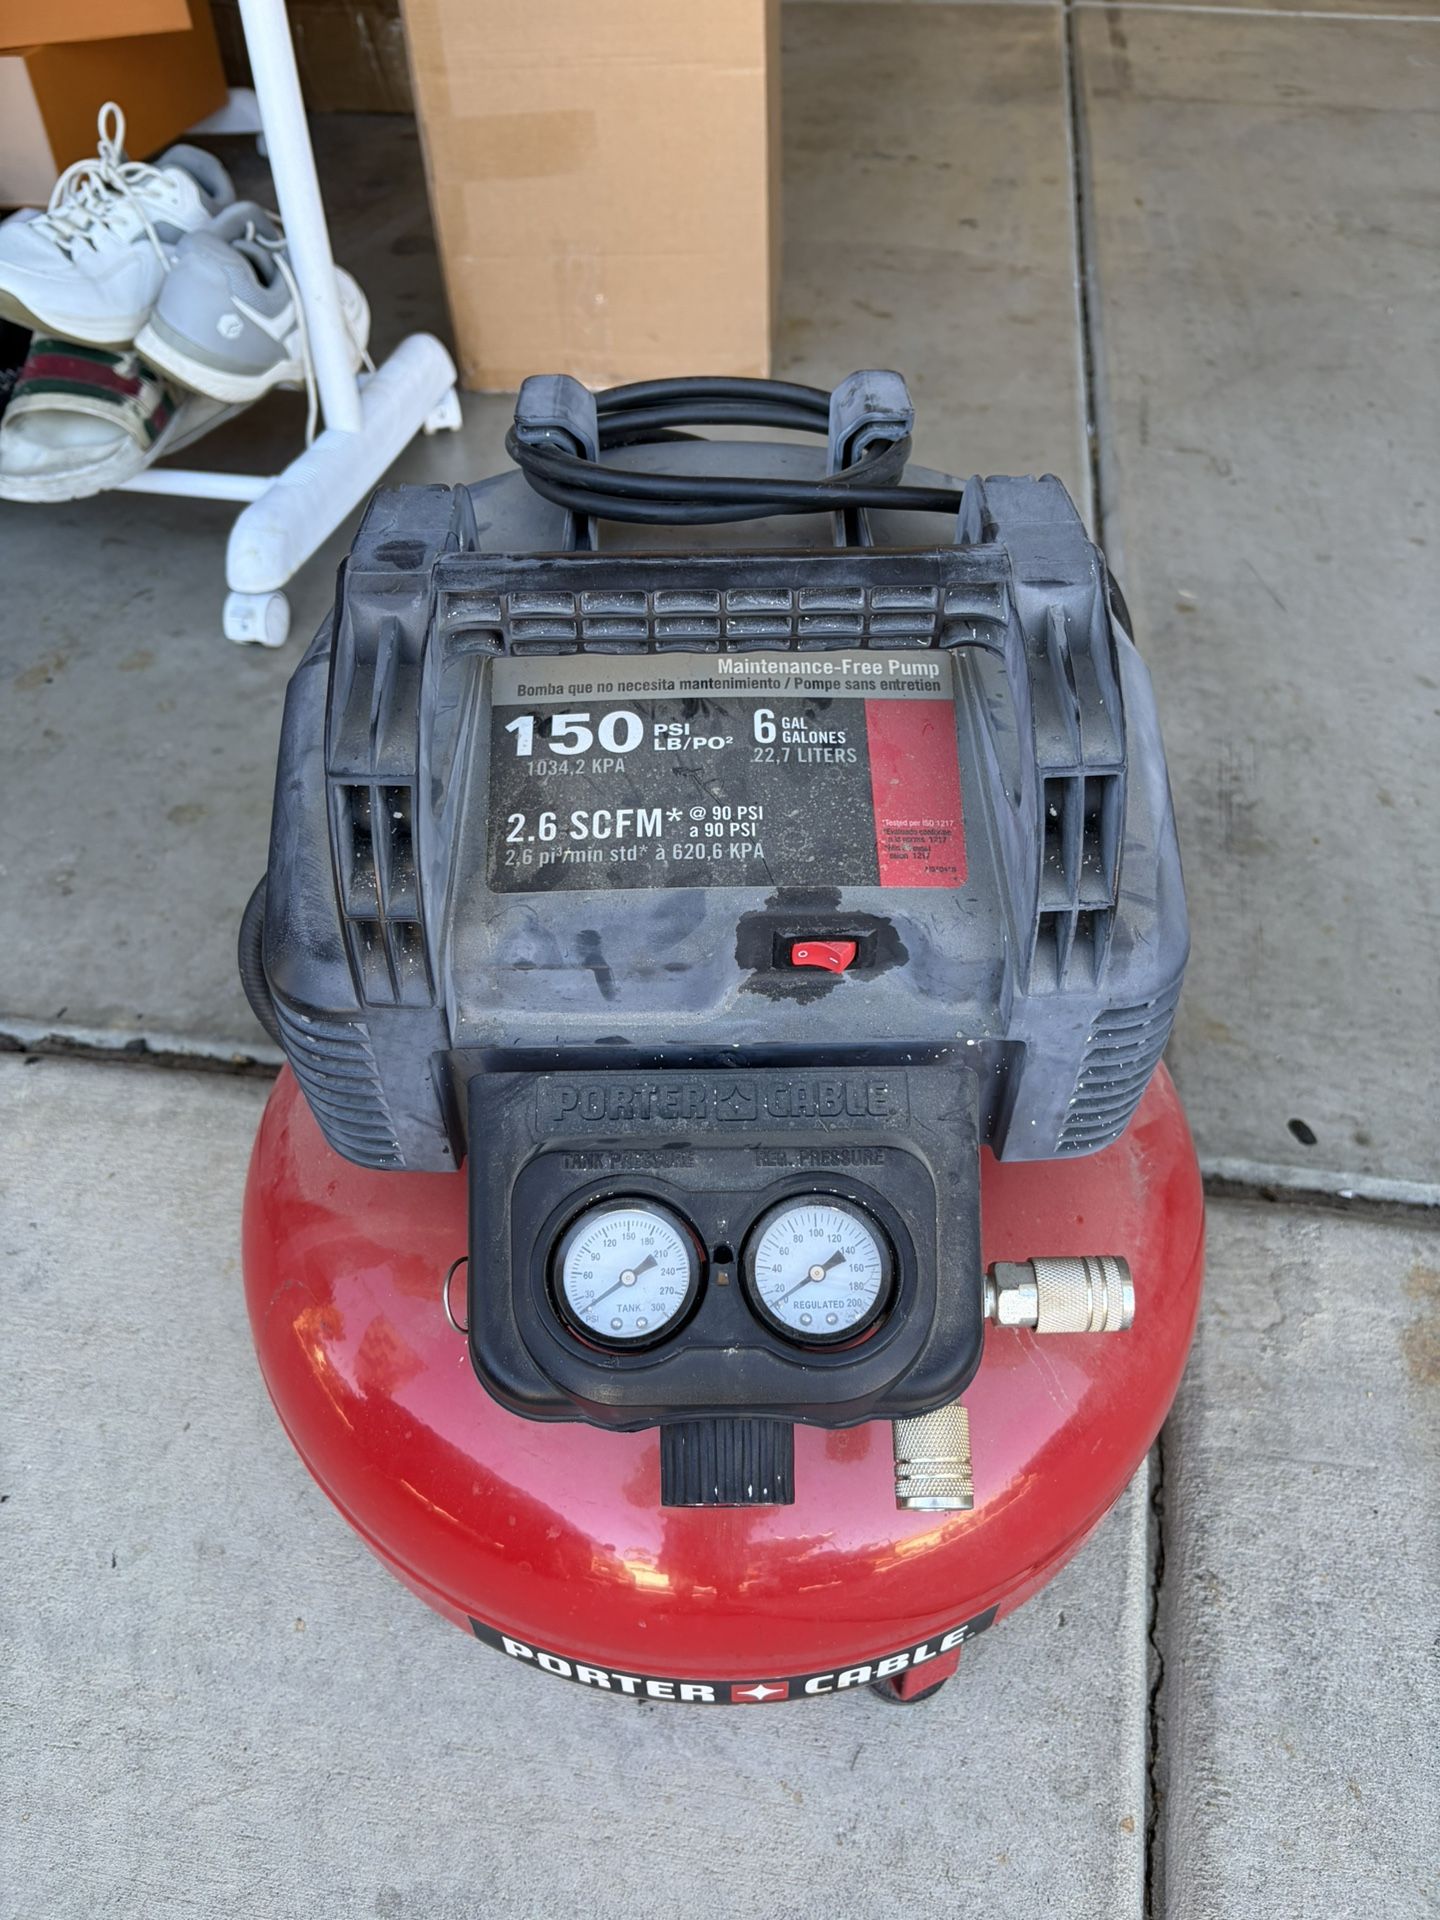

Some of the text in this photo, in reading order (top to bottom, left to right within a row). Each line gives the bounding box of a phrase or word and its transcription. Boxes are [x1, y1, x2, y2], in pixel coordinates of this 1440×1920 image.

[718, 658, 940, 678] Maintenance-Free Pump
[517, 677, 941, 697] Bomba que no necesita mantenimiento / Pompe sans entretien
[753, 708, 776, 743] 6
[782, 717, 808, 729] GAL
[505, 710, 644, 756] 150
[654, 723, 690, 736] PSI
[782, 731, 846, 744] GALONES
[654, 736, 734, 751] LB/PO²
[753, 747, 857, 765] 22,7 LITERS
[528, 758, 625, 776] 1034,2 KPA
[689, 806, 763, 820] @ 90 PSI
[506, 812, 557, 843] 2.6
[936, 819, 954, 827] 1217
[689, 822, 756, 837] a 90 PSI
[505, 849, 532, 866] 2,6
[656, 845, 666, 861] à
[672, 842, 723, 861] 620,6
[729, 842, 764, 859] KPA
[553, 1081, 888, 1122] PORTER CABLE
[562, 1151, 697, 1170] TANK PRESSURE
[800, 1149, 885, 1167] PRESSURE
[622, 1233, 636, 1241] 150
[809, 1229, 824, 1237] 100
[603, 1239, 617, 1247] 120
[640, 1238, 655, 1246] 180
[793, 1234, 803, 1243] 80
[827, 1234, 842, 1243] 120
[654, 1250, 668, 1258] 210
[779, 1247, 789, 1256] 60
[840, 1246, 855, 1255] 140
[591, 1252, 601, 1261] 90
[660, 1267, 676, 1276] 240
[772, 1264, 782, 1273] 40
[849, 1263, 864, 1272] 160
[583, 1271, 593, 1279] 60
[660, 1287, 675, 1295] 270
[775, 1284, 785, 1292] 20
[849, 1282, 864, 1291] 180
[584, 1290, 595, 1299] 30
[793, 1300, 845, 1309] REGULATED
[847, 1298, 862, 1307] 200
[616, 1304, 641, 1313] TANK
[651, 1304, 666, 1312] 300
[585, 1315, 599, 1323] PSI
[501, 1625, 969, 1701] PORTER CABLE
